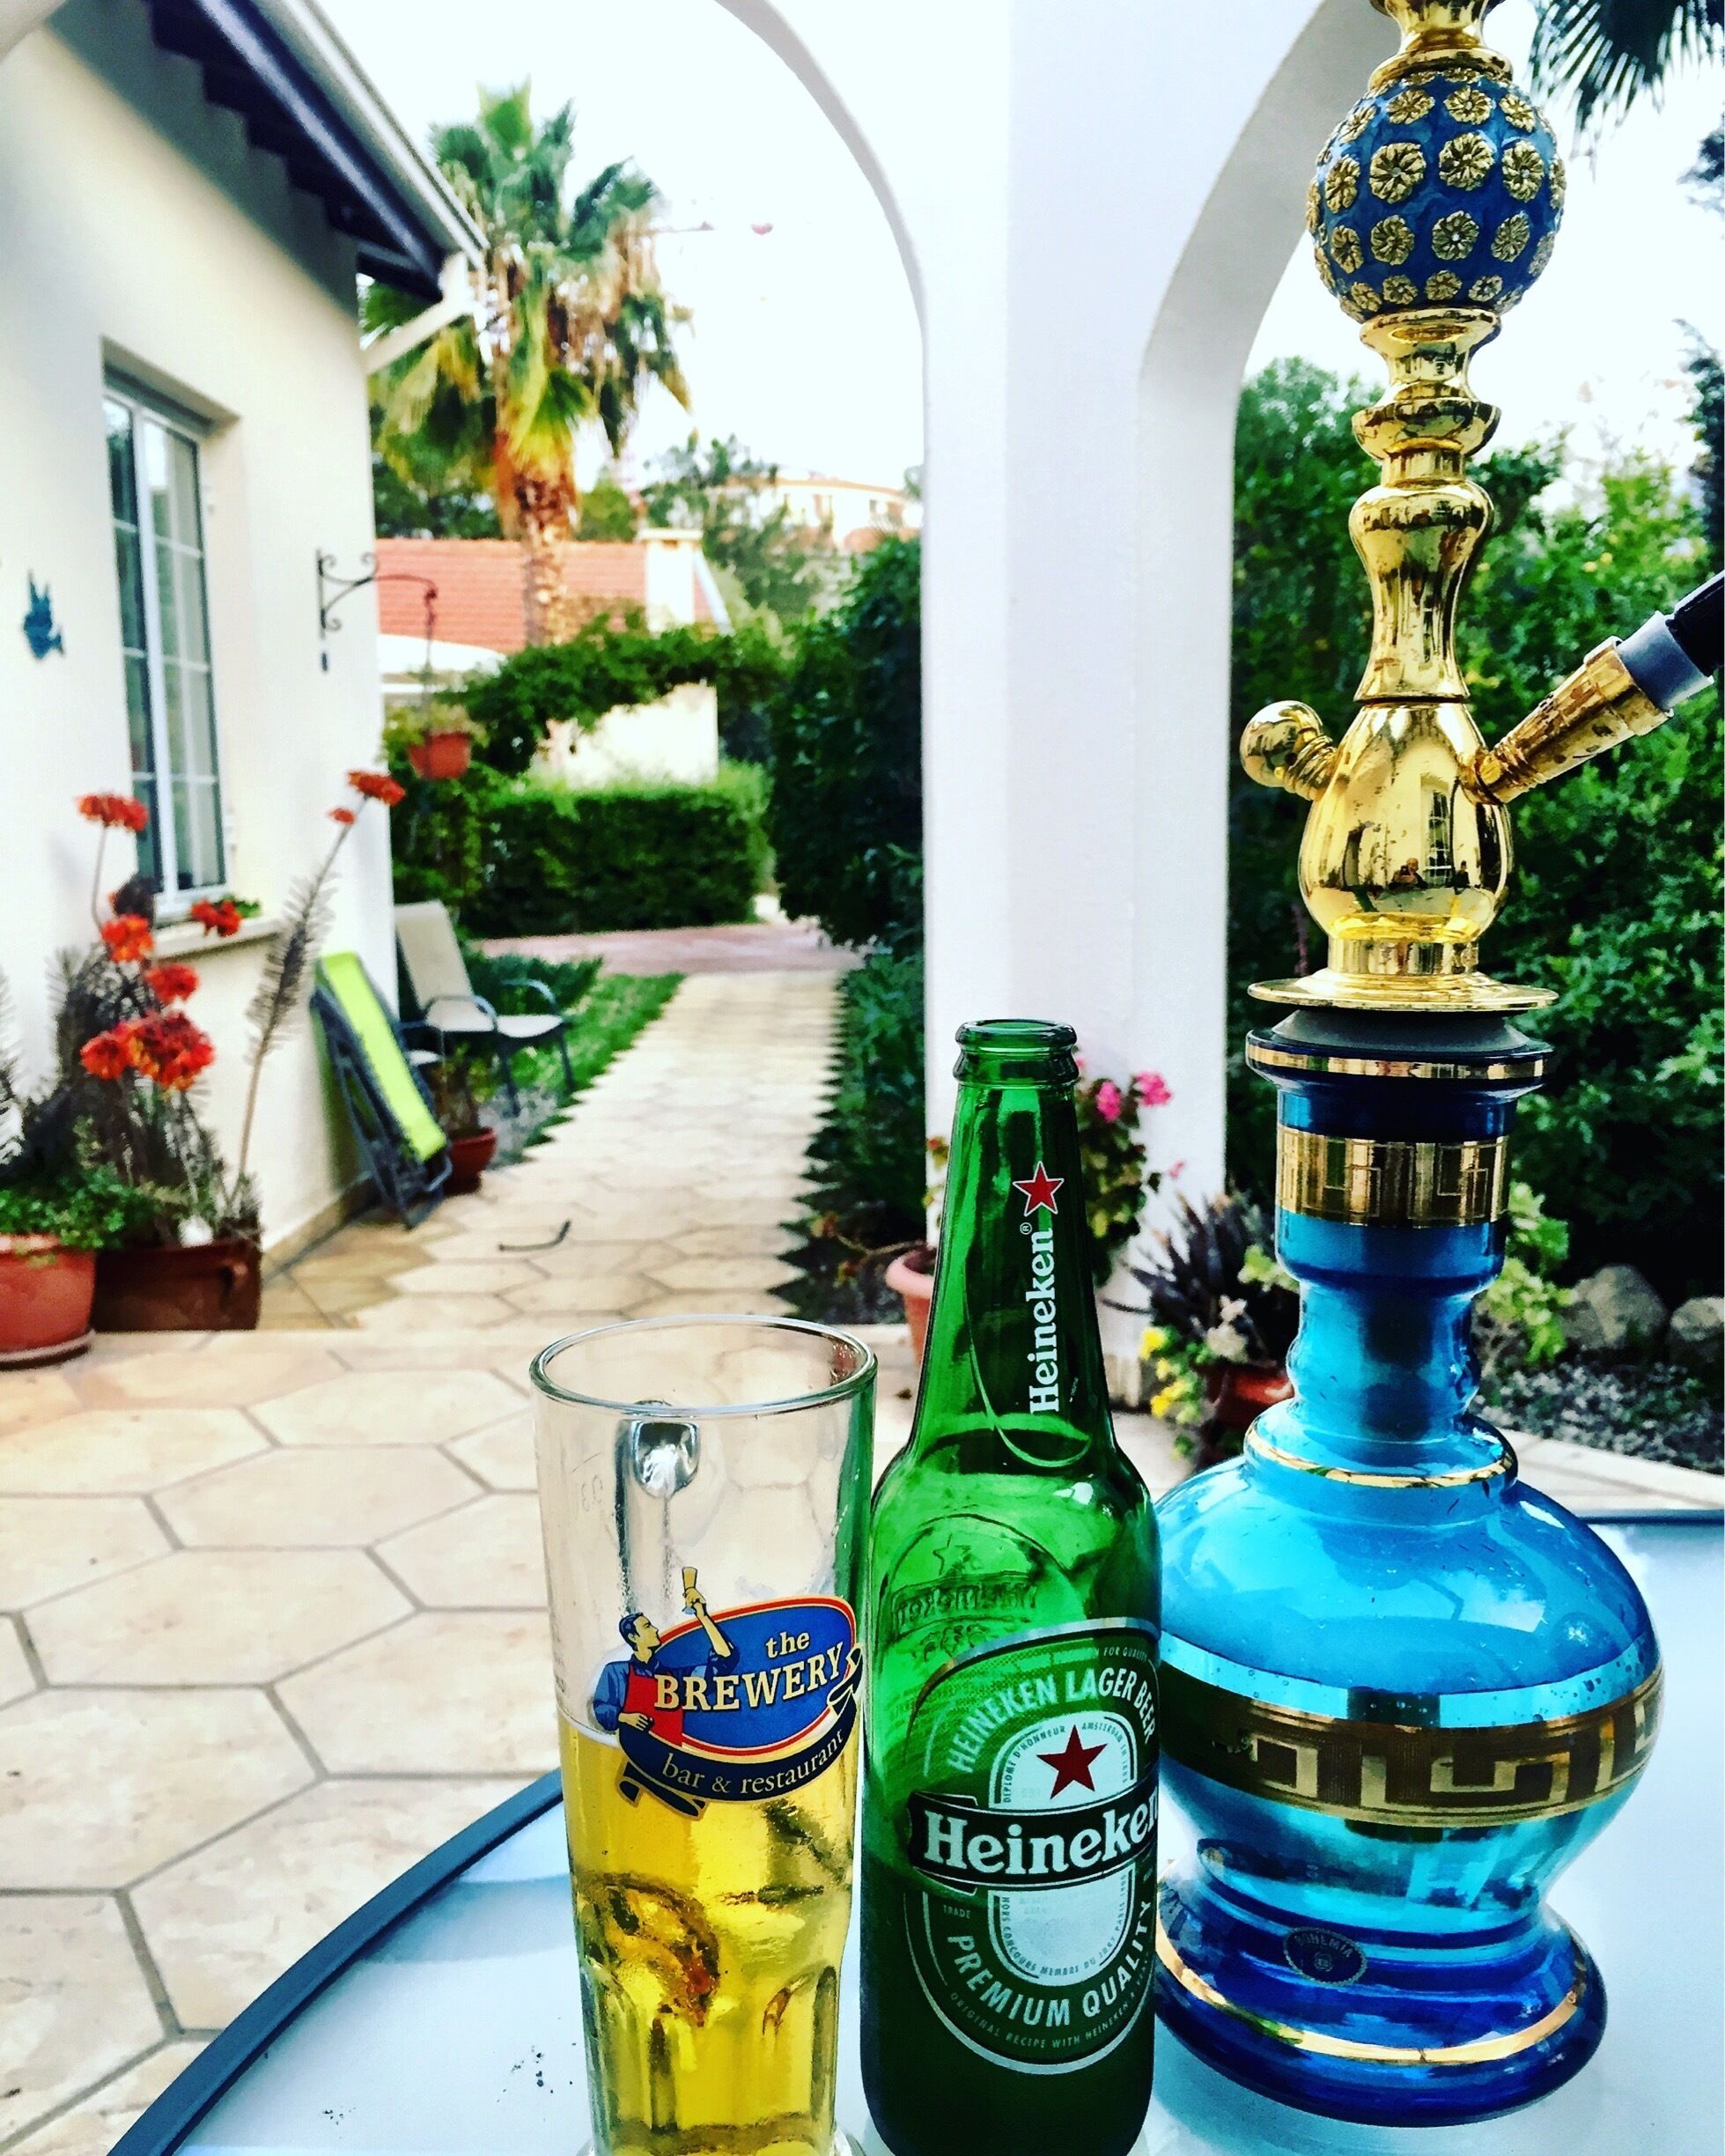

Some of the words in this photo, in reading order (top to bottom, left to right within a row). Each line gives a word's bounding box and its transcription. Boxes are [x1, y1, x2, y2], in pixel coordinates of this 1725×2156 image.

[1025, 1228, 1059, 1414] Heineken
[653, 1641, 845, 1712] BREWERY
[765, 1630, 810, 1659] the
[1103, 1645, 1121, 1657] FOR
[946, 1673, 1059, 1774] HEINEKEN
[1065, 1666, 1139, 1702] LAGER
[1132, 1680, 1157, 1745] BEER
[662, 1753, 704, 1790] bar
[711, 1776, 731, 1794] &
[740, 1728, 844, 1795] restaurant
[924, 1786, 1159, 1875] Heineken
[942, 1903, 971, 1919] TRADE
[947, 1934, 1071, 2027] PREMIUM
[1081, 1900, 1152, 2018] QUALITY
[950, 1992, 1000, 2037] ORIGINAL
[1006, 2032, 1046, 2049] RECIPE
[1051, 2036, 1080, 2049] WITH
[1085, 2002, 1129, 2041] HEINEKEN
